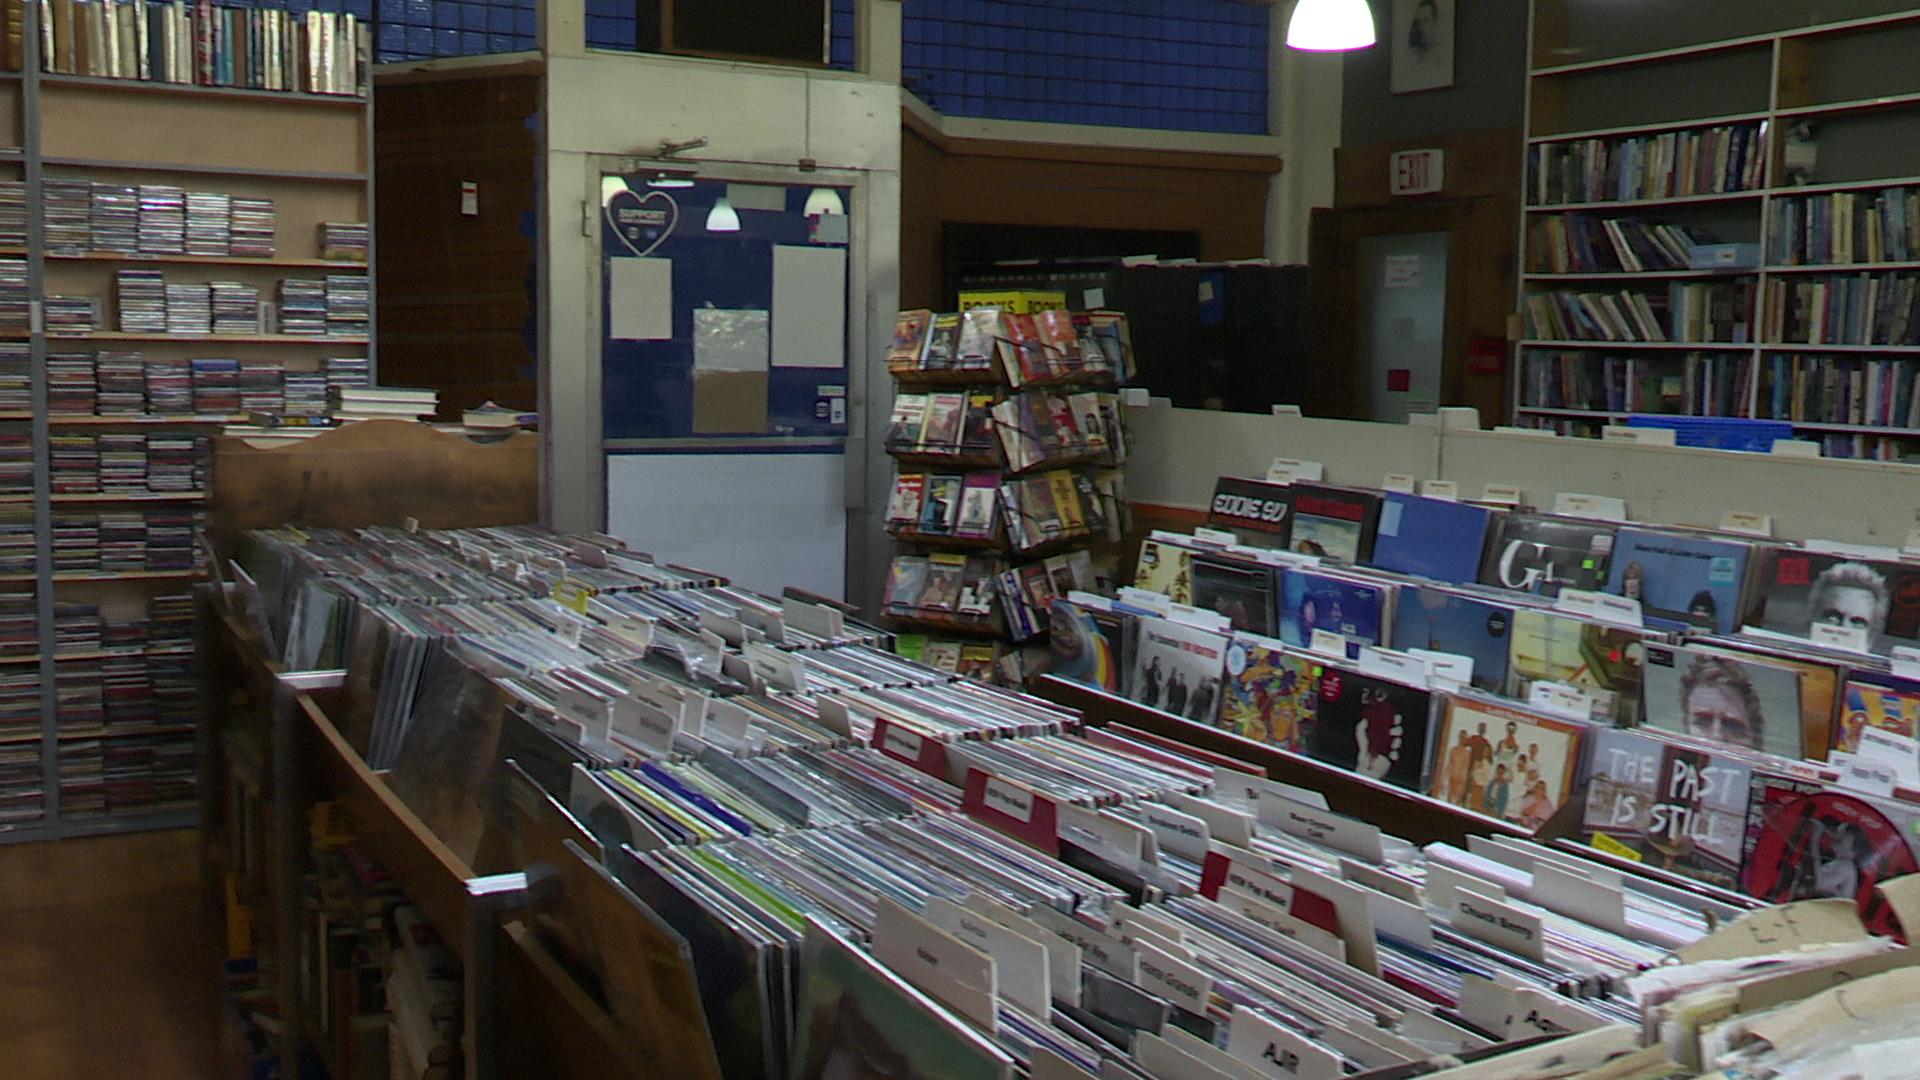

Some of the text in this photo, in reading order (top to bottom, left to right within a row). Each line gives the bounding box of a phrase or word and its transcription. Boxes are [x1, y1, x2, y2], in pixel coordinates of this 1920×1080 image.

[1398, 151, 1432, 190] EXIT
[1212, 493, 1263, 520] EDDIE
[1608, 747, 1741, 805] THE PAST
[1609, 792, 1639, 827] IS
[1649, 803, 1724, 845] STILL
[1459, 902, 1533, 940] Chuck Berry
